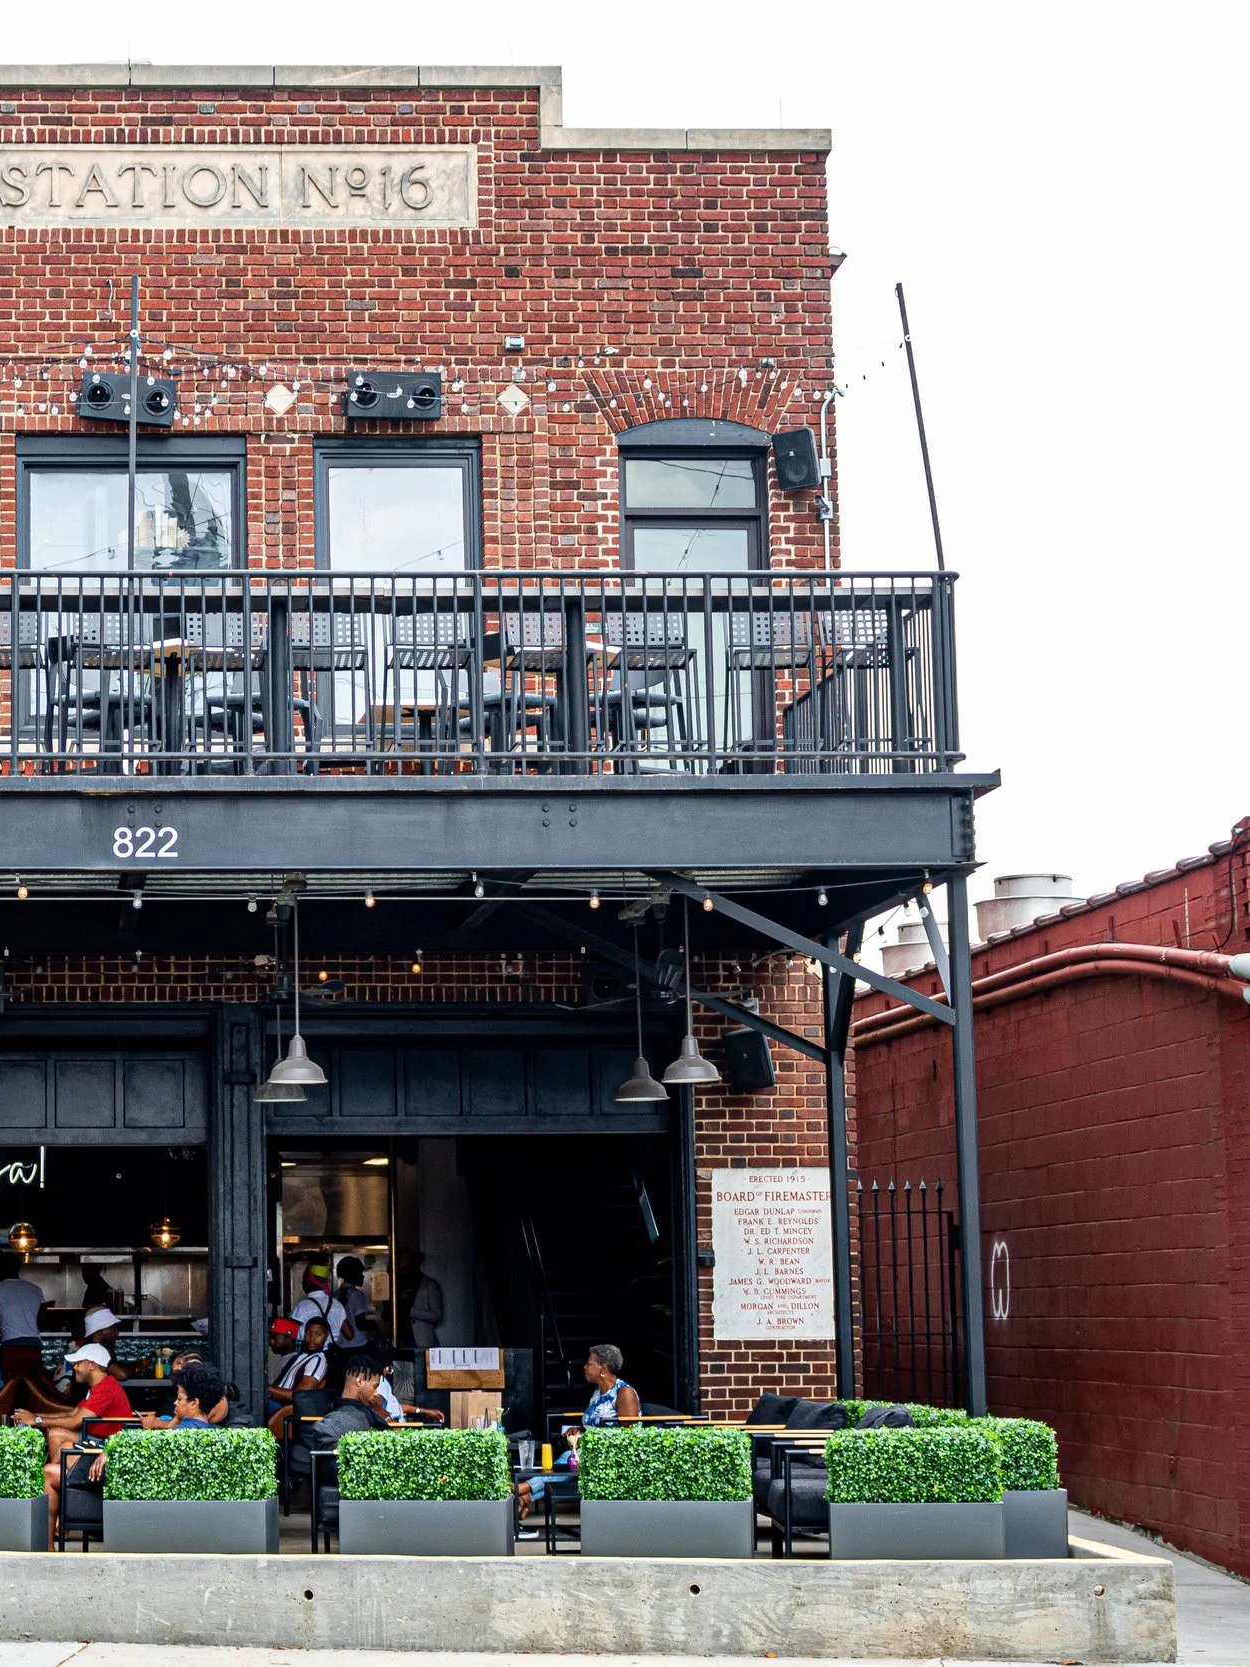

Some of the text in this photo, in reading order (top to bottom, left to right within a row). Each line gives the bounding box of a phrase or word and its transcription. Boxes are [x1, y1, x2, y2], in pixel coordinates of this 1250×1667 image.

[0, 162, 269, 209] STATION
[112, 826, 179, 858] 822
[716, 1191, 755, 1202] BOARD
[734, 1208, 759, 1216] EDGAR
[764, 1208, 795, 1216] DUNLAP
